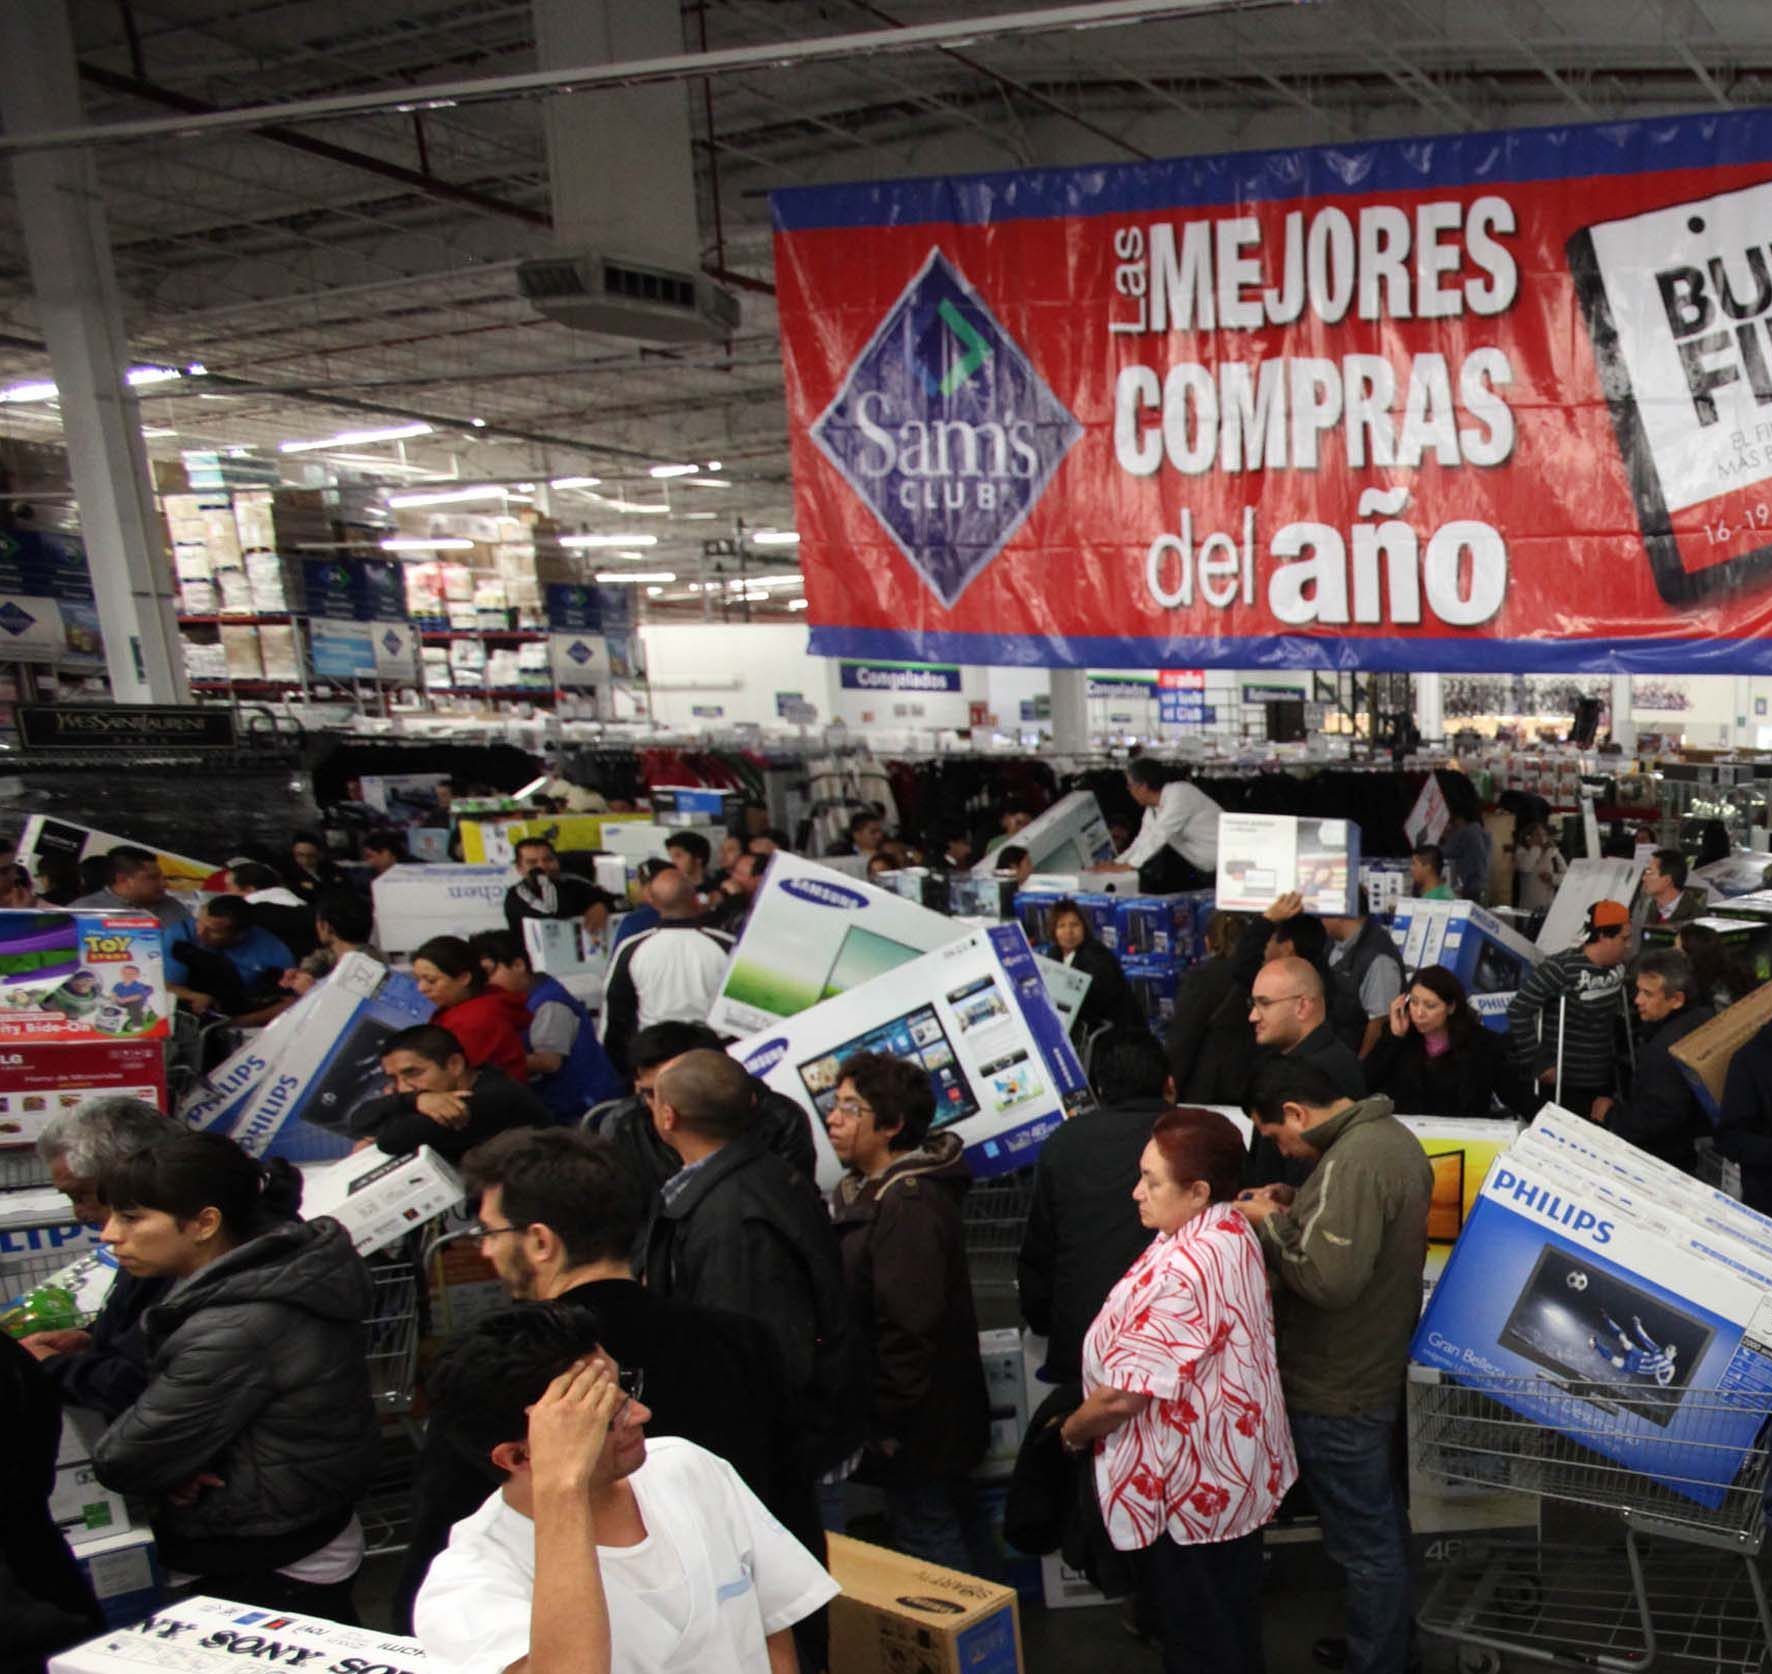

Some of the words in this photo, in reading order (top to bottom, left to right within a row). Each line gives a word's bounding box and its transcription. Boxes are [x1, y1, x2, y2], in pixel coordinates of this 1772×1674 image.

[1110, 226, 1146, 333] Las
[1150, 196, 1517, 332] MEJORES
[1114, 347, 1514, 477] COMPRAS
[855, 391, 1039, 481] Sam's
[1730, 429, 1750, 451] EL
[901, 481, 997, 511] CLUB
[1146, 505, 1255, 610] del
[1268, 486, 1508, 627] año
[856, 667, 948, 690] Congelados
[789, 880, 858, 909] SAMSUNG
[84, 936, 135, 953] TOY
[241, 1073, 300, 1152] PHILIPS
[1493, 1169, 1615, 1245] PHILIPS
[0, 1223, 103, 1253] LIPS
[1428, 1331, 1459, 1356] Gran
[200, 1629, 327, 1667] SONY
